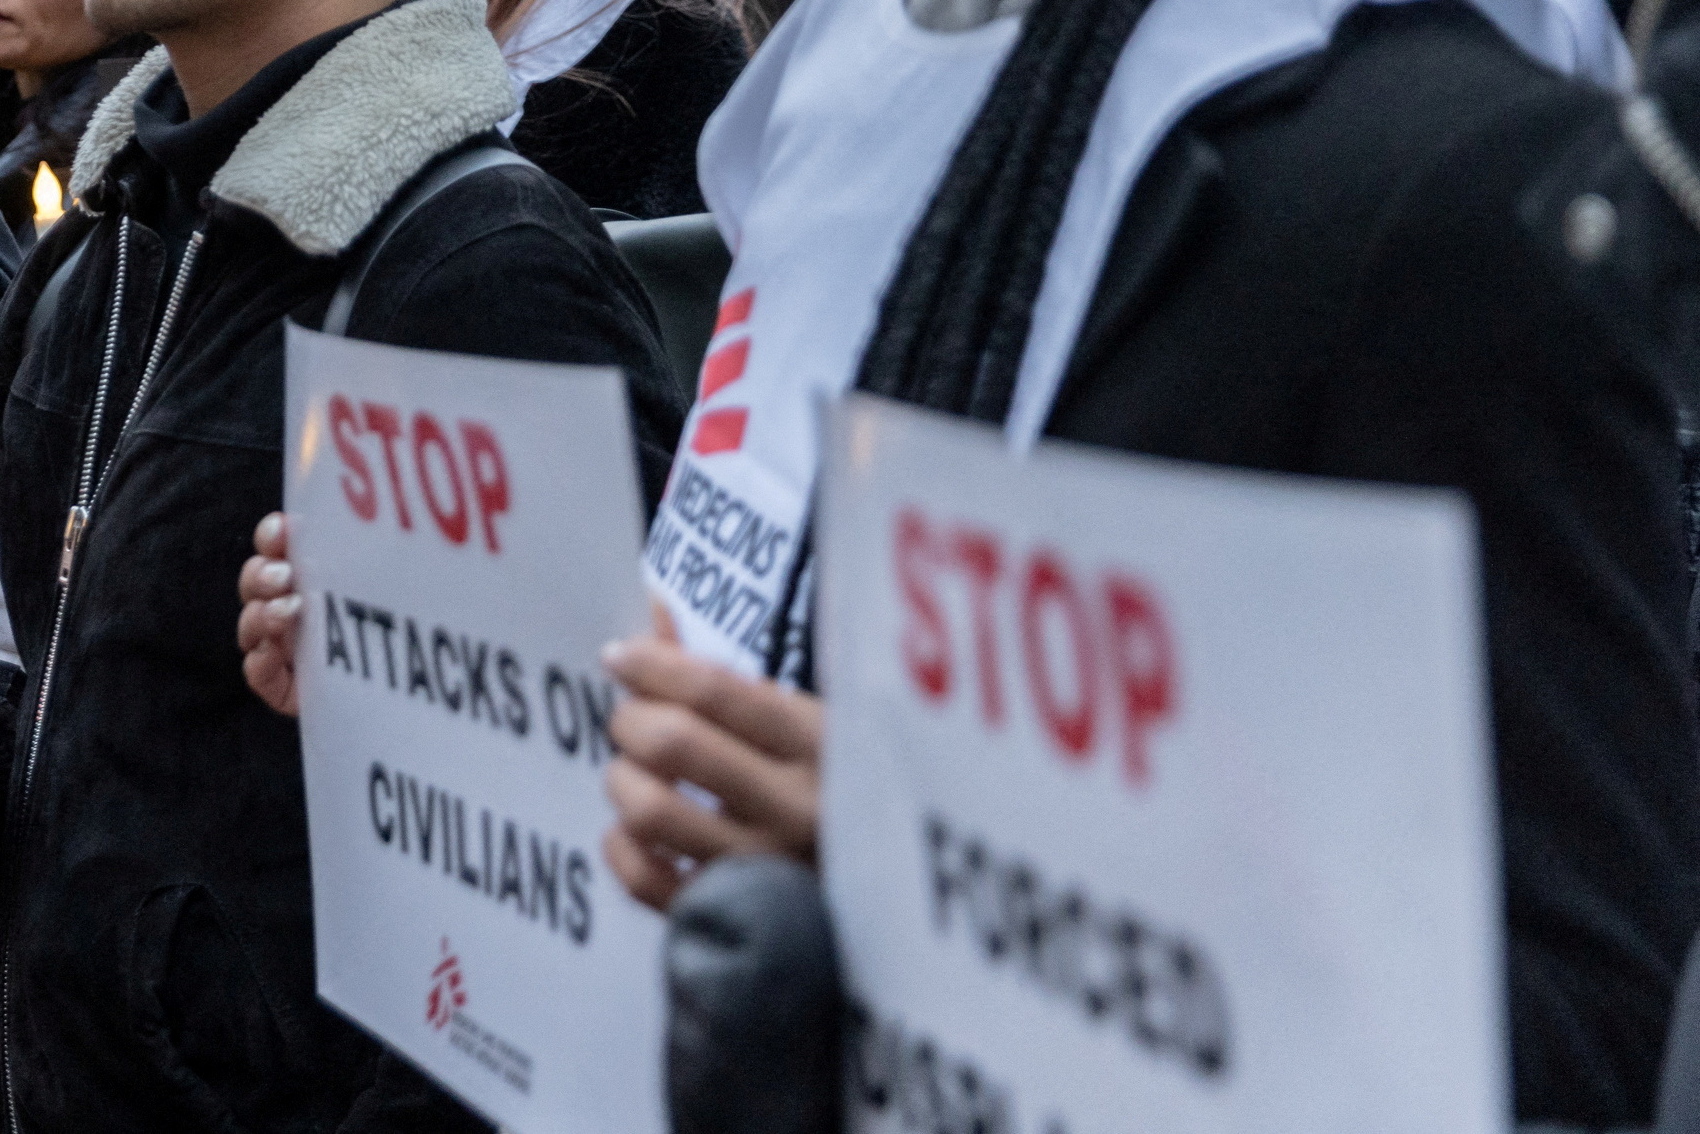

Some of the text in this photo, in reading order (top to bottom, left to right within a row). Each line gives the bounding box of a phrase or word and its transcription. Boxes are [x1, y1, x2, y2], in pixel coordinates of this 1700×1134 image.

[328, 393, 513, 556] STOP
[324, 591, 621, 765] ATTACKS ON
[890, 502, 1184, 790] STOP
[367, 761, 594, 946] CIVILIANS
